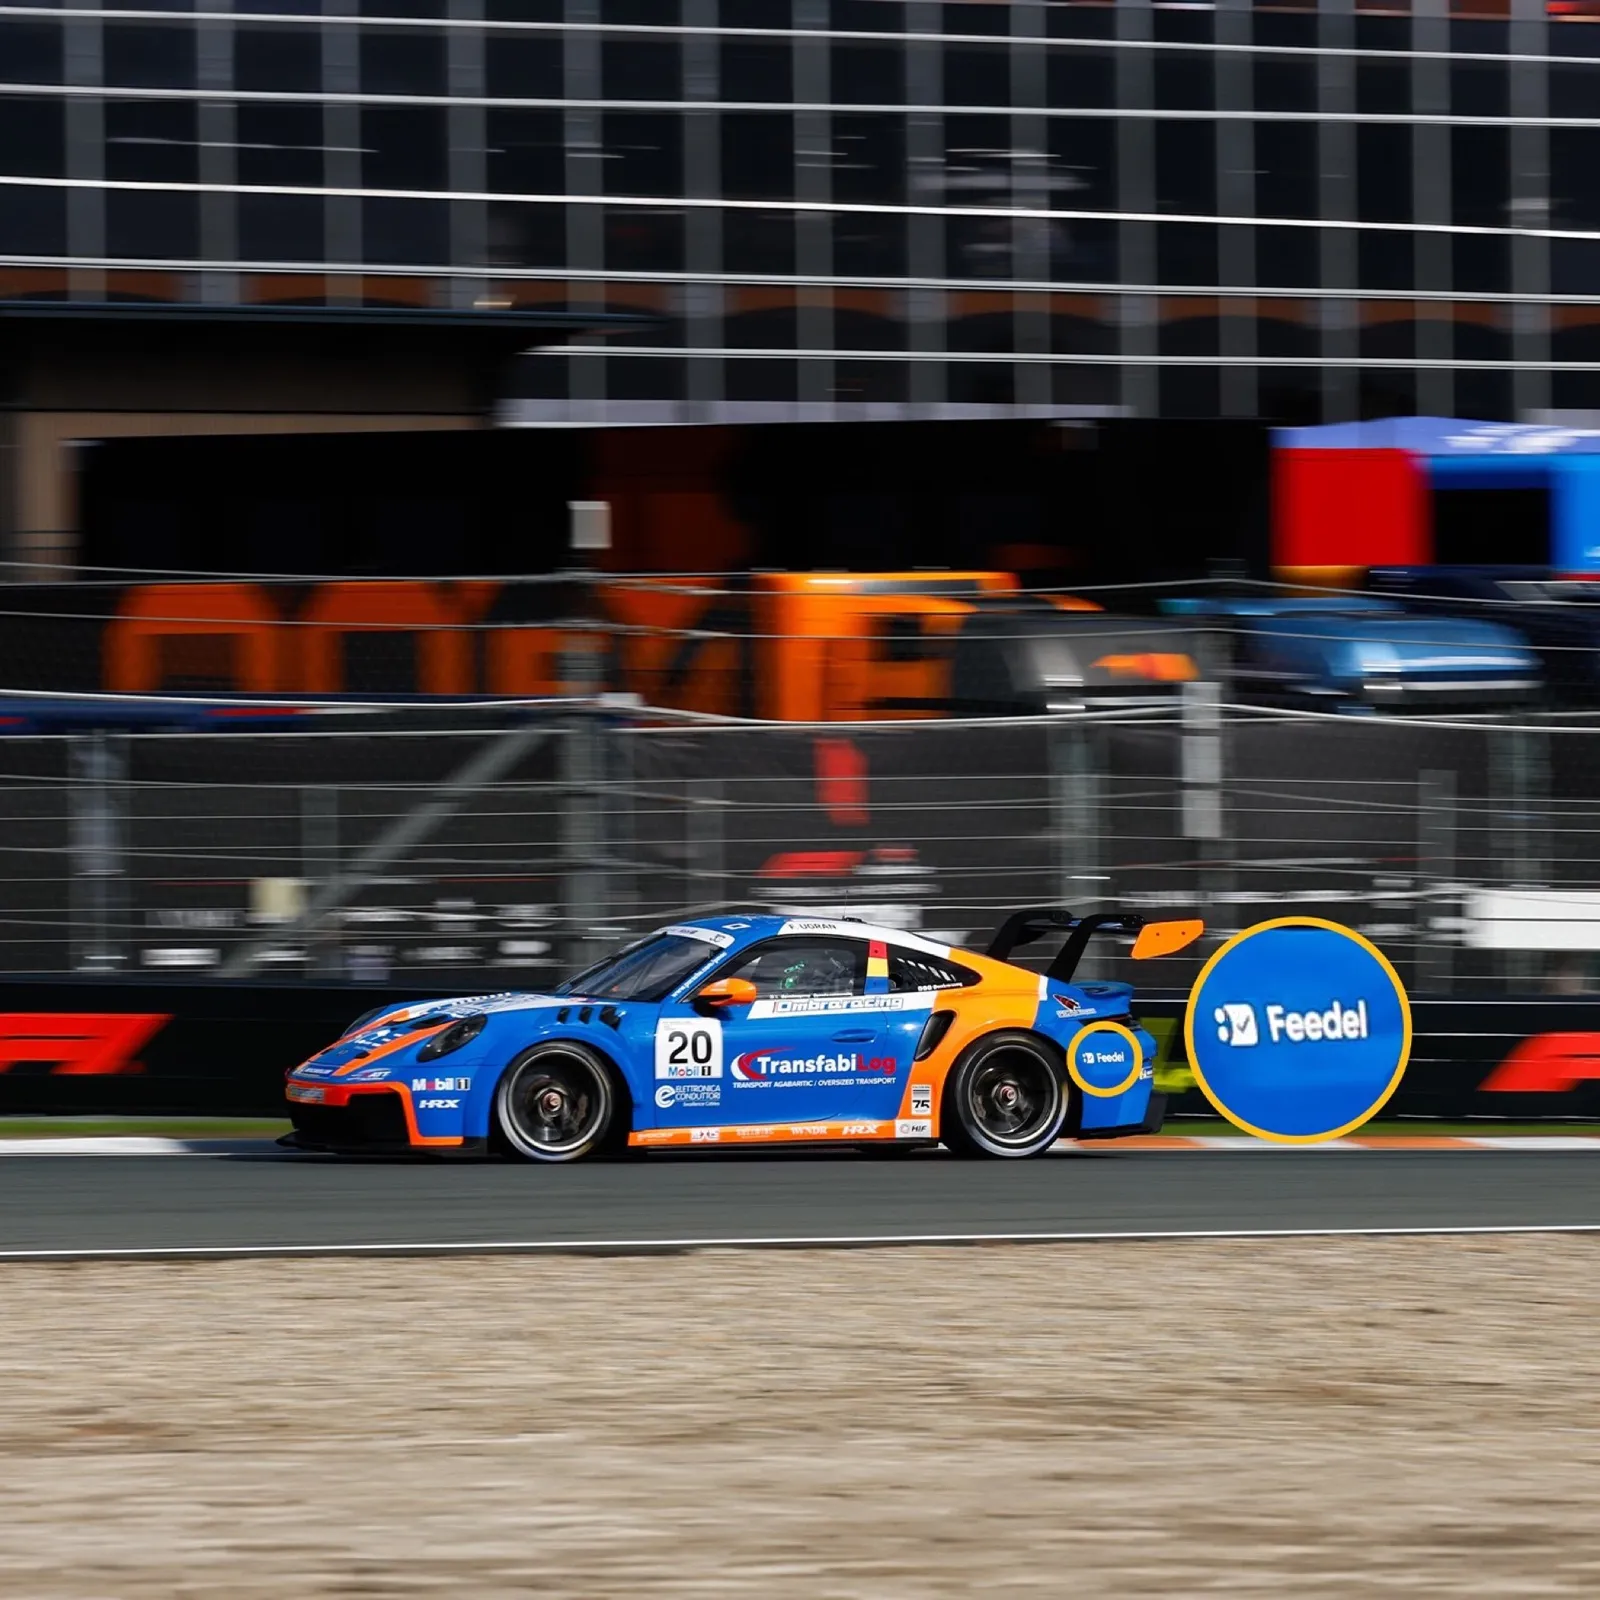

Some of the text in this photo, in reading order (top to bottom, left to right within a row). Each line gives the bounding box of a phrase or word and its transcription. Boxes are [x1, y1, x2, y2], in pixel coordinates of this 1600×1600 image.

[668, 1030, 712, 1064] 20
[1096, 1051, 1125, 1063] Feedel
[756, 1053, 897, 1076] TransfabiLog
[668, 1065, 712, 1077] Mobil 1
[412, 1077, 471, 1092] Mobil 1
[675, 1084, 721, 1092] ELETTRONICA
[733, 1080, 773, 1089] TRANSPORT
[773, 1080, 813, 1088] AGABARITIC
[818, 1078, 855, 1087] OVERSIZED
[855, 1077, 897, 1086] TRANSPORT
[418, 1099, 461, 1109] HRX
[841, 1124, 879, 1136] HRX
